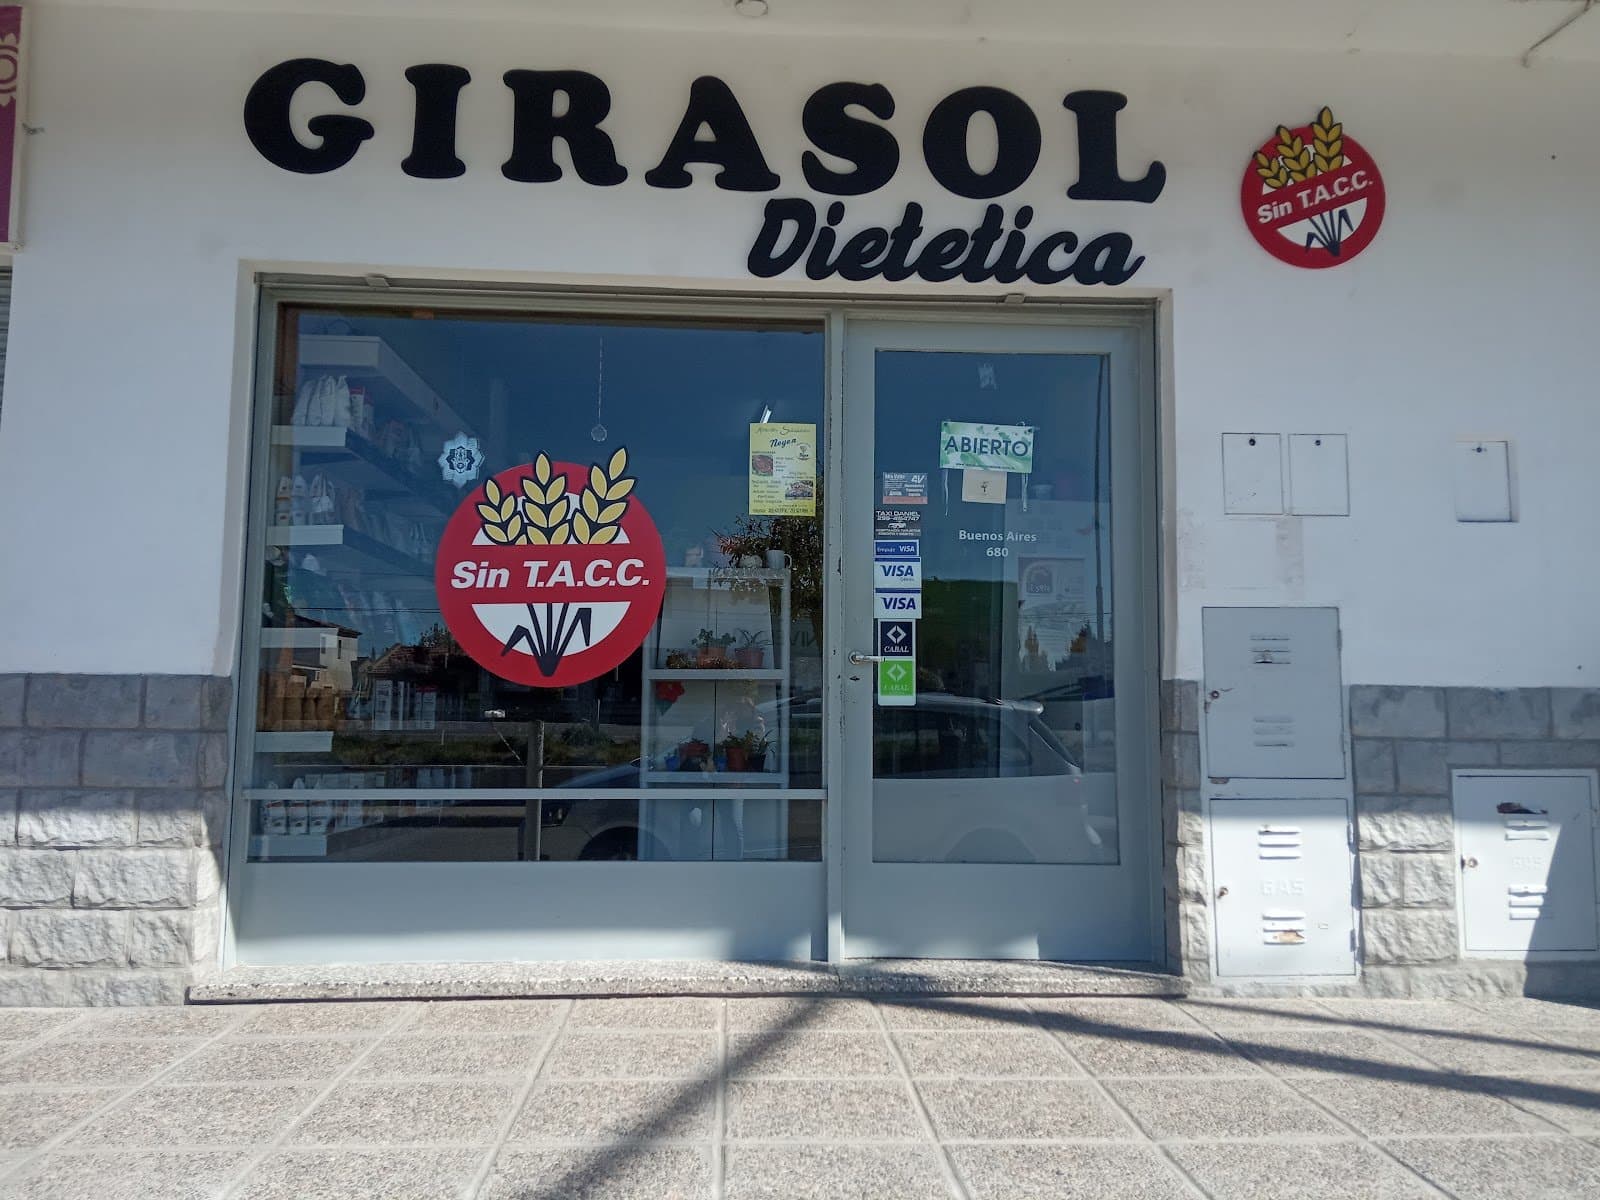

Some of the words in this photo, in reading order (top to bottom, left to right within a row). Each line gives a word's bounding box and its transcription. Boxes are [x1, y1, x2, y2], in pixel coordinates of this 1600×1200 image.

[244, 58, 1167, 203] GIRASOL
[1257, 201, 1293, 224] Sin
[1296, 170, 1374, 209] T.A.C.C.
[747, 198, 1146, 286] Dietetica
[944, 435, 1028, 457] ABIERTO
[959, 530, 1003, 541] Buenos
[1006, 531, 1037, 542] Aires
[986, 547, 1009, 557] 680
[451, 560, 510, 588] Sin
[523, 558, 650, 588] T.A.C.C.
[880, 565, 914, 576] VISA
[880, 597, 916, 610] VISA
[884, 645, 910, 653] CABAL
[1259, 879, 1305, 897] GAS
